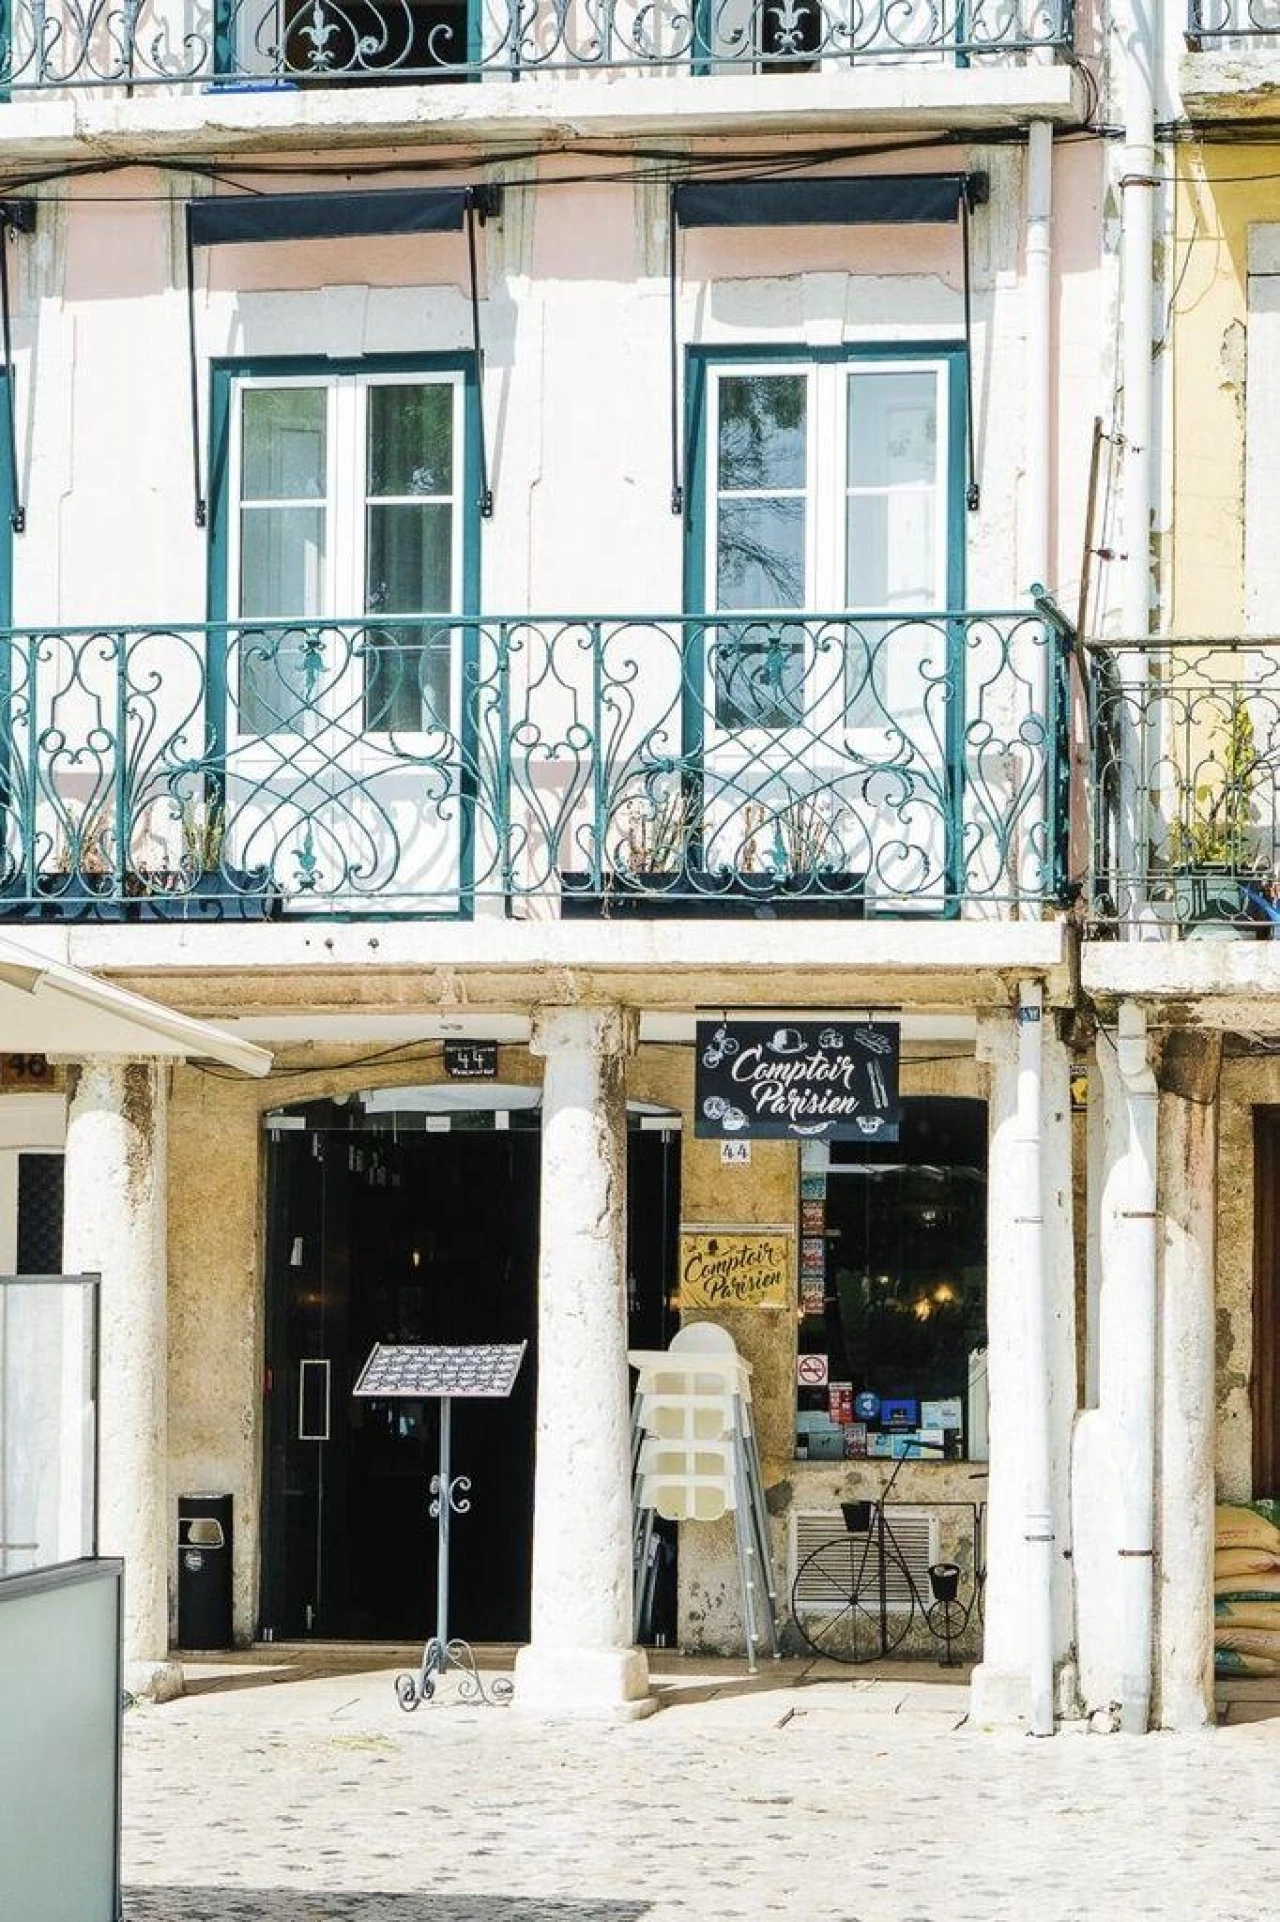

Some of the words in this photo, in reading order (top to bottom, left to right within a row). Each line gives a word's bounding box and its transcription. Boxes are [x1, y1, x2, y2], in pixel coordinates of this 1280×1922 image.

[457, 1046, 485, 1069] 44
[732, 1043, 855, 1089] Comptoir
[751, 1081, 860, 1121] Parisien
[722, 1144, 749, 1159] 44
[684, 1242, 777, 1282] Comptoir
[704, 1270, 781, 1301] Parisien
